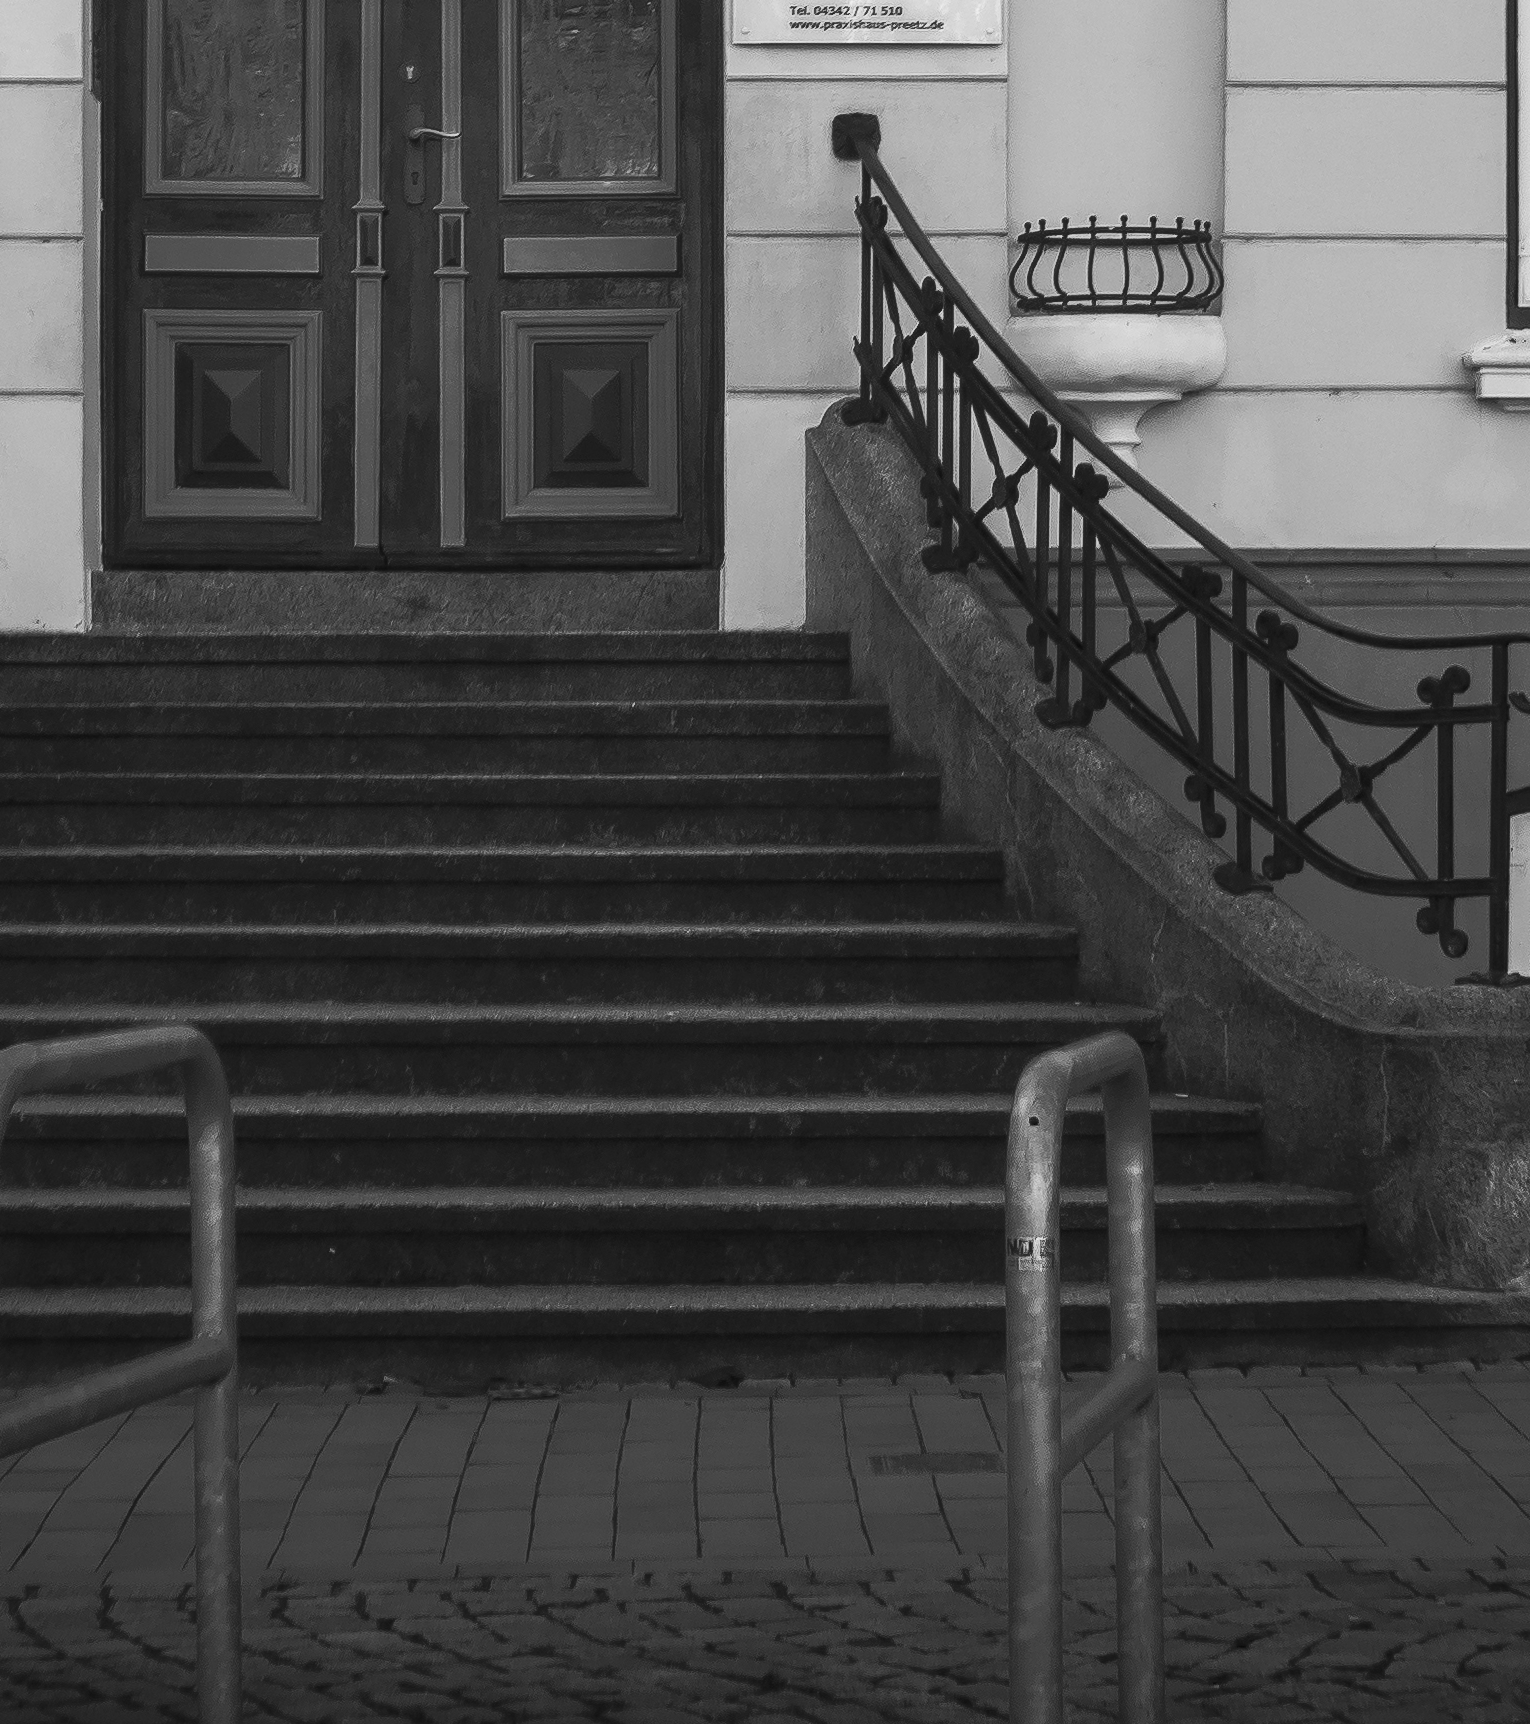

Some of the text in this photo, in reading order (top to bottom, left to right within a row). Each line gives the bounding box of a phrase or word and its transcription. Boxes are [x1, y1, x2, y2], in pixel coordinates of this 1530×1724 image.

[789, 5, 904, 17] Tel. 04342 / 71 510
[789, 19, 945, 32] www.praxishaus-preetz.de
